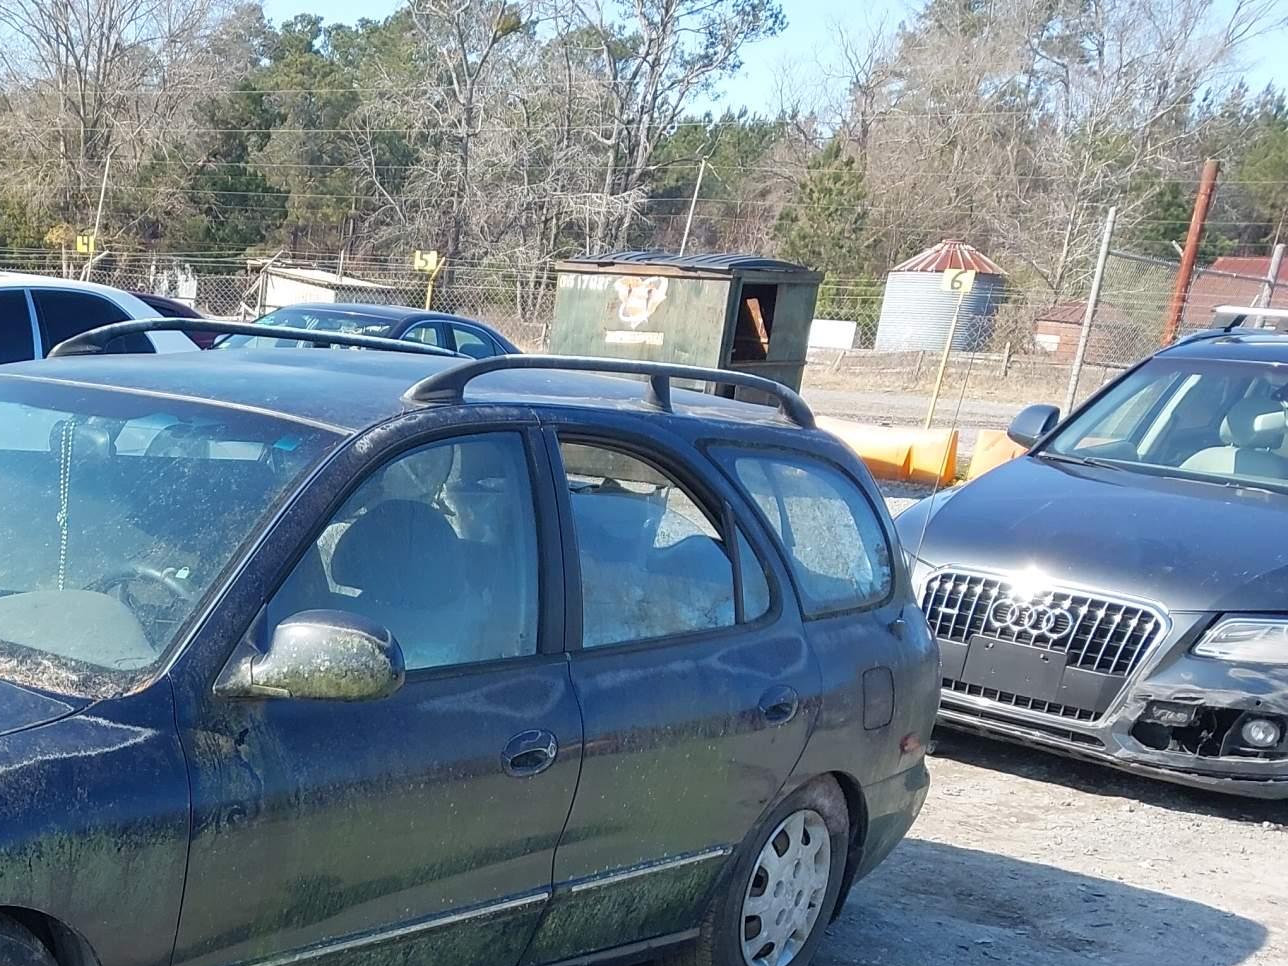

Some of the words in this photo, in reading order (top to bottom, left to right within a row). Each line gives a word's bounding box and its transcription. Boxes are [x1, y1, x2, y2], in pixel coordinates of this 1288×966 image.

[81, 234, 90, 252] 4
[419, 250, 429, 268] 5
[950, 270, 968, 290] 6
